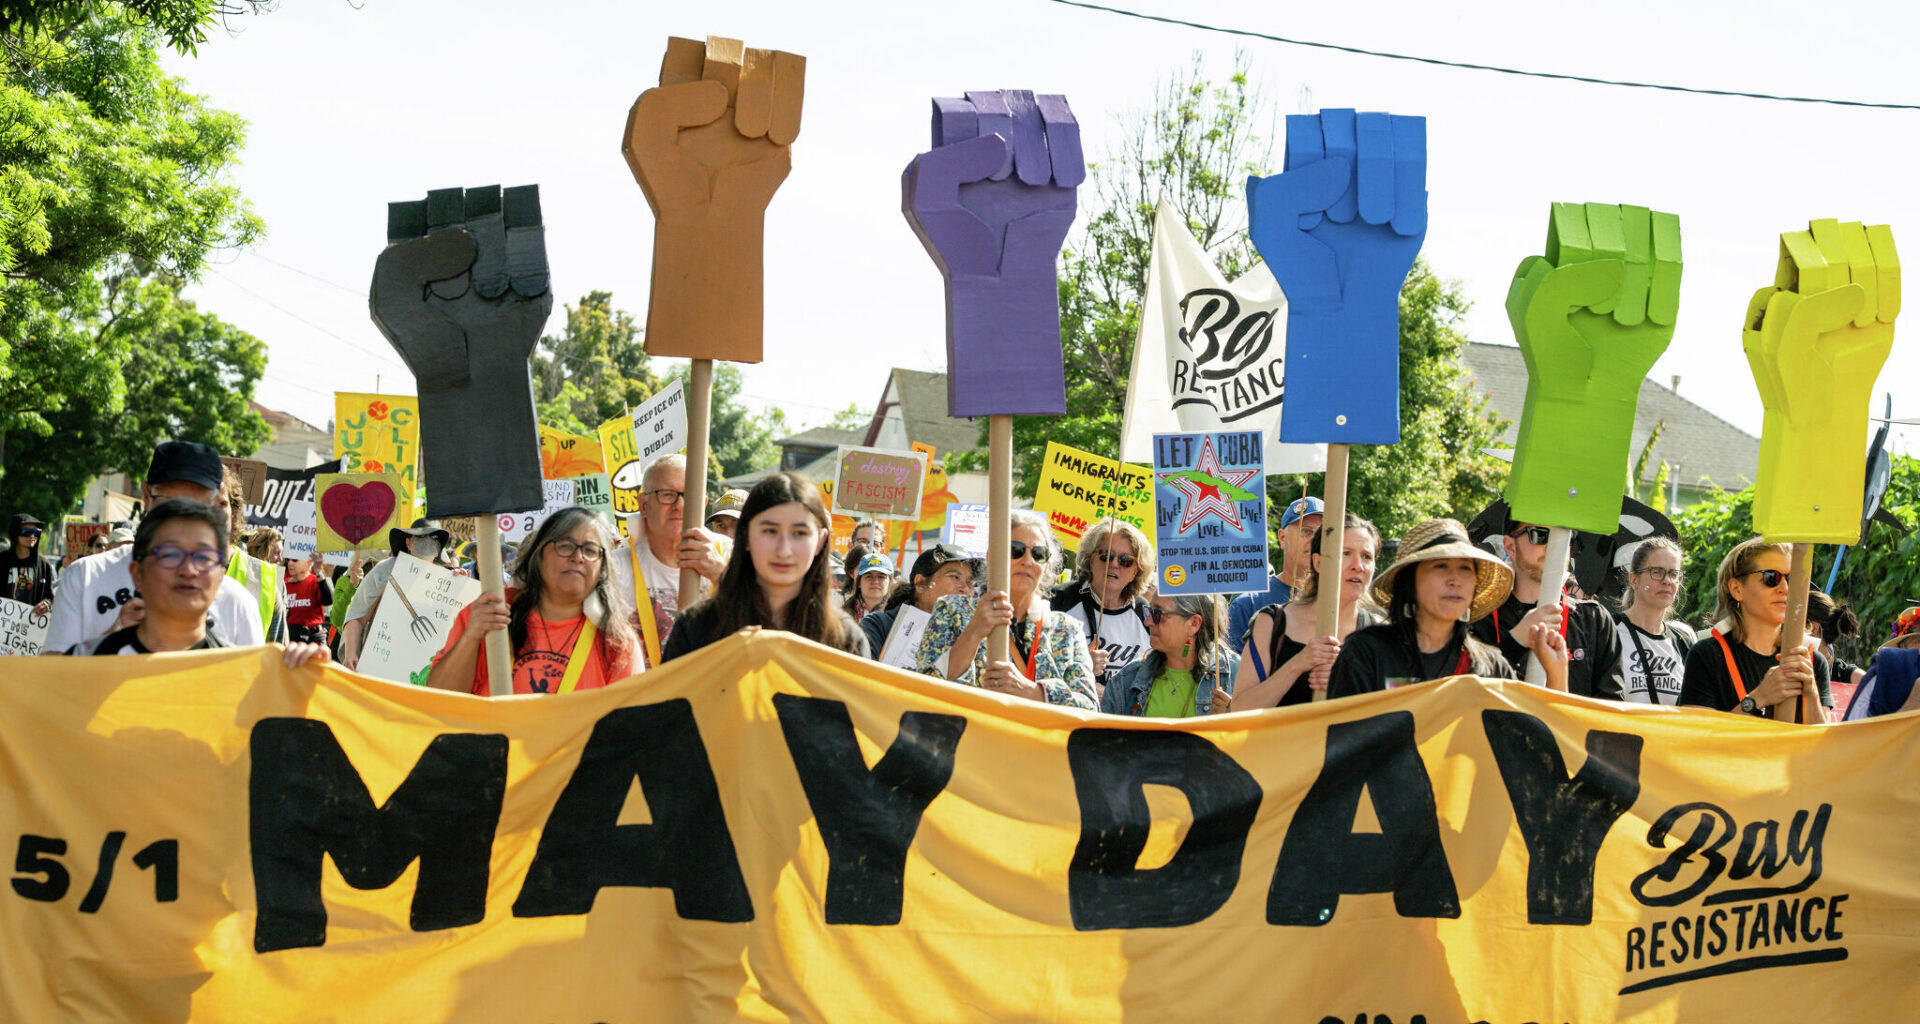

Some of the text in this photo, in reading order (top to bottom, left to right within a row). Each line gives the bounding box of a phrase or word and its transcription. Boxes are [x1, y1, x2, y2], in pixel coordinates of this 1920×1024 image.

[634, 389, 683, 429] KEEP ICE OUT
[654, 419, 665, 433] OF
[561, 439, 576, 450] UP
[644, 431, 674, 457] DUBLIN
[1159, 433, 1261, 468] LET CUBA
[860, 456, 911, 485] destroy
[546, 482, 570, 491] UND
[846, 480, 907, 500] FASCISM
[1101, 480, 1151, 503] RIGHTS
[577, 494, 609, 506] PELES
[1158, 497, 1182, 527] LIVE!
[1240, 502, 1262, 523] LIVE!
[292, 525, 316, 536] CORR
[1198, 521, 1224, 539] LIVE!
[1160, 548, 1178, 556] STOP
[1180, 547, 1193, 556] THE
[1195, 547, 1208, 555] U.S.
[1210, 546, 1229, 555] SIEGE
[1231, 545, 1241, 553] ON
[1209, 560, 1220, 570] AL
[1222, 558, 1264, 569] GENOCIDA
[409, 562, 452, 593] In a gig
[425, 589, 463, 608] econom
[435, 609, 449, 621] the
[377, 631, 392, 643] the
[373, 641, 391, 662] frog
[11, 692, 1645, 954] 5/1 MAY DAY
[1629, 801, 1833, 908] Bay
[1625, 893, 1849, 974] RESISTANCE
